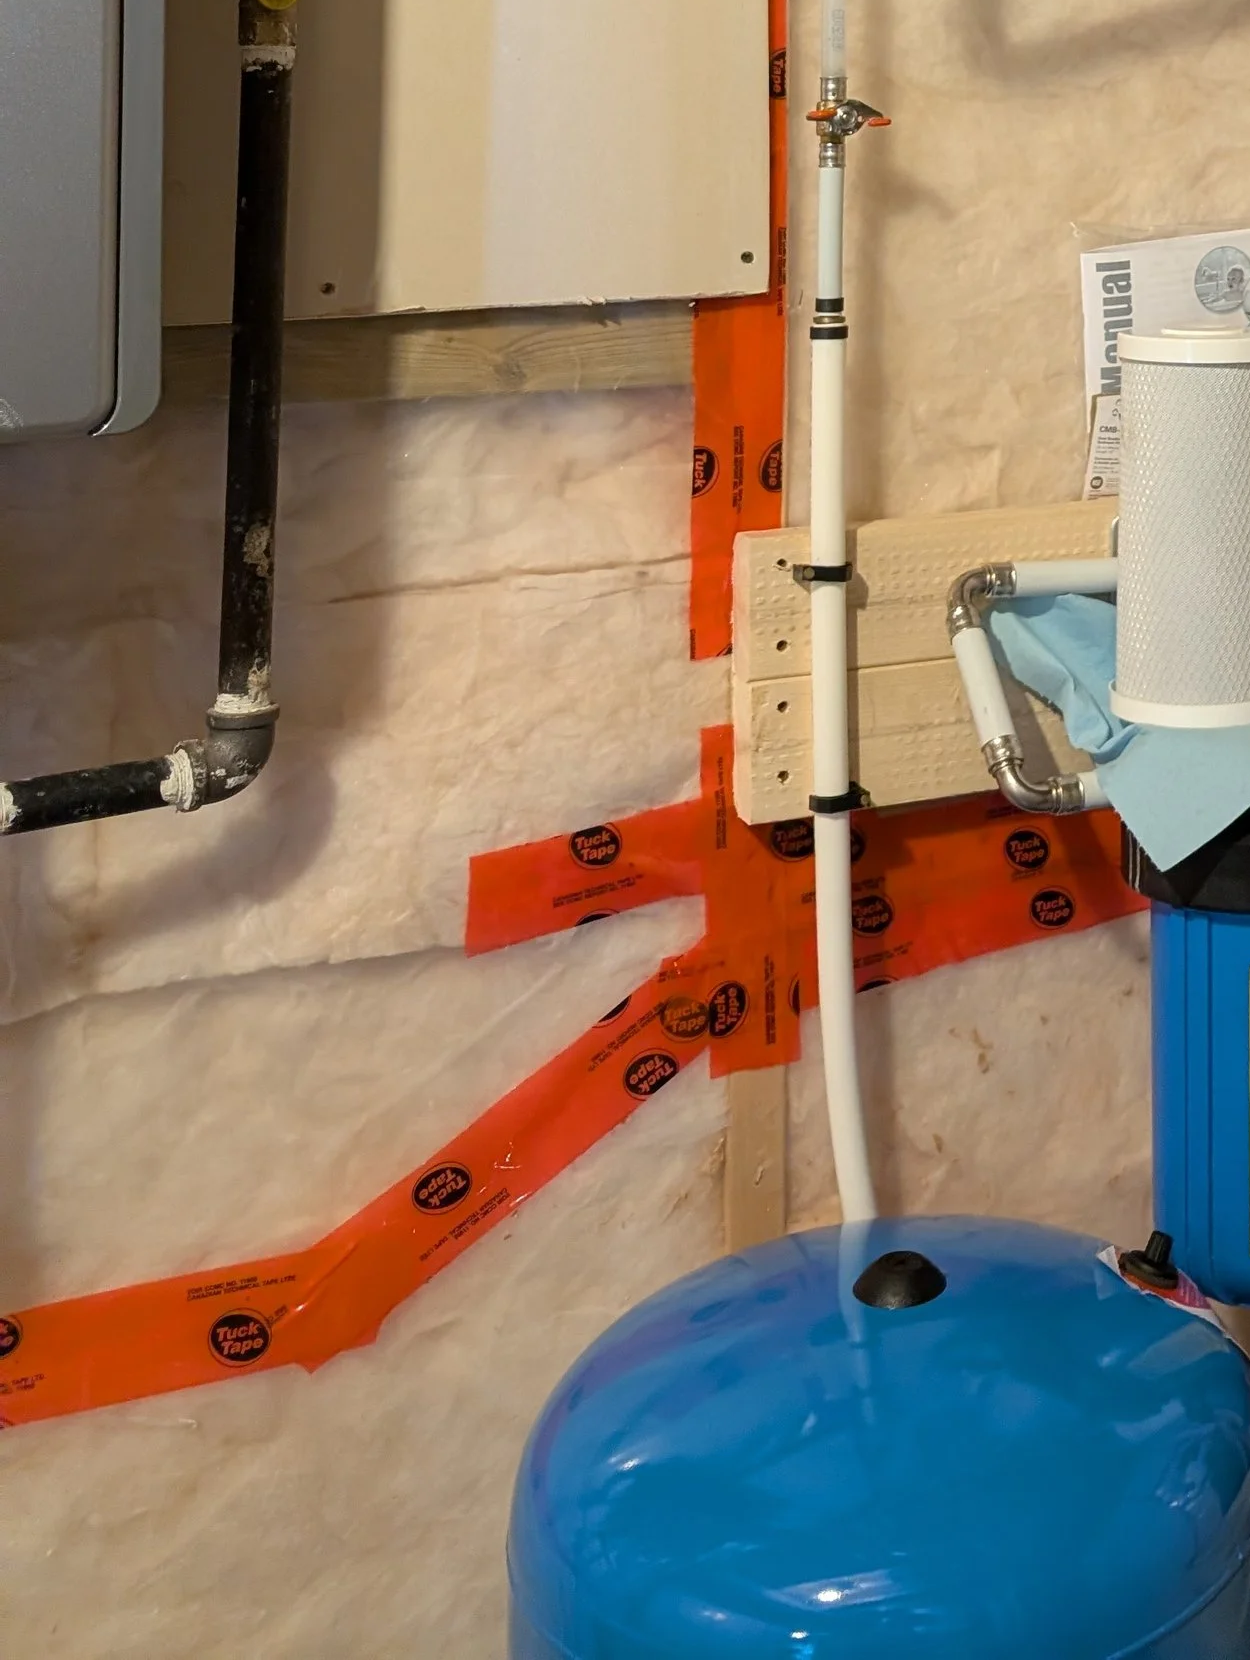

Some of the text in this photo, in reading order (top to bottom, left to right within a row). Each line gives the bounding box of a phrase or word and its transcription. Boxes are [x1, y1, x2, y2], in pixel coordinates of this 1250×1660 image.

[694, 452, 707, 489] Tuck
[767, 450, 780, 487] Tape
[574, 830, 612, 852] Tuck
[579, 841, 617, 862] Tape
[1010, 836, 1041, 853] Tuck
[1015, 848, 1045, 863] Tape
[1034, 896, 1067, 913] Tuck
[1039, 907, 1071, 923] Tape
[714, 991, 726, 1034] Tuck
[728, 986, 741, 1026] Tape
[671, 1013, 706, 1034] Tape
[629, 1055, 665, 1086] Tape
[637, 1063, 676, 1095] Tuck
[418, 1168, 457, 1200] Tape
[428, 1175, 467, 1207] Tuck
[216, 1321, 259, 1342] Tuck
[221, 1337, 264, 1355] Tape
